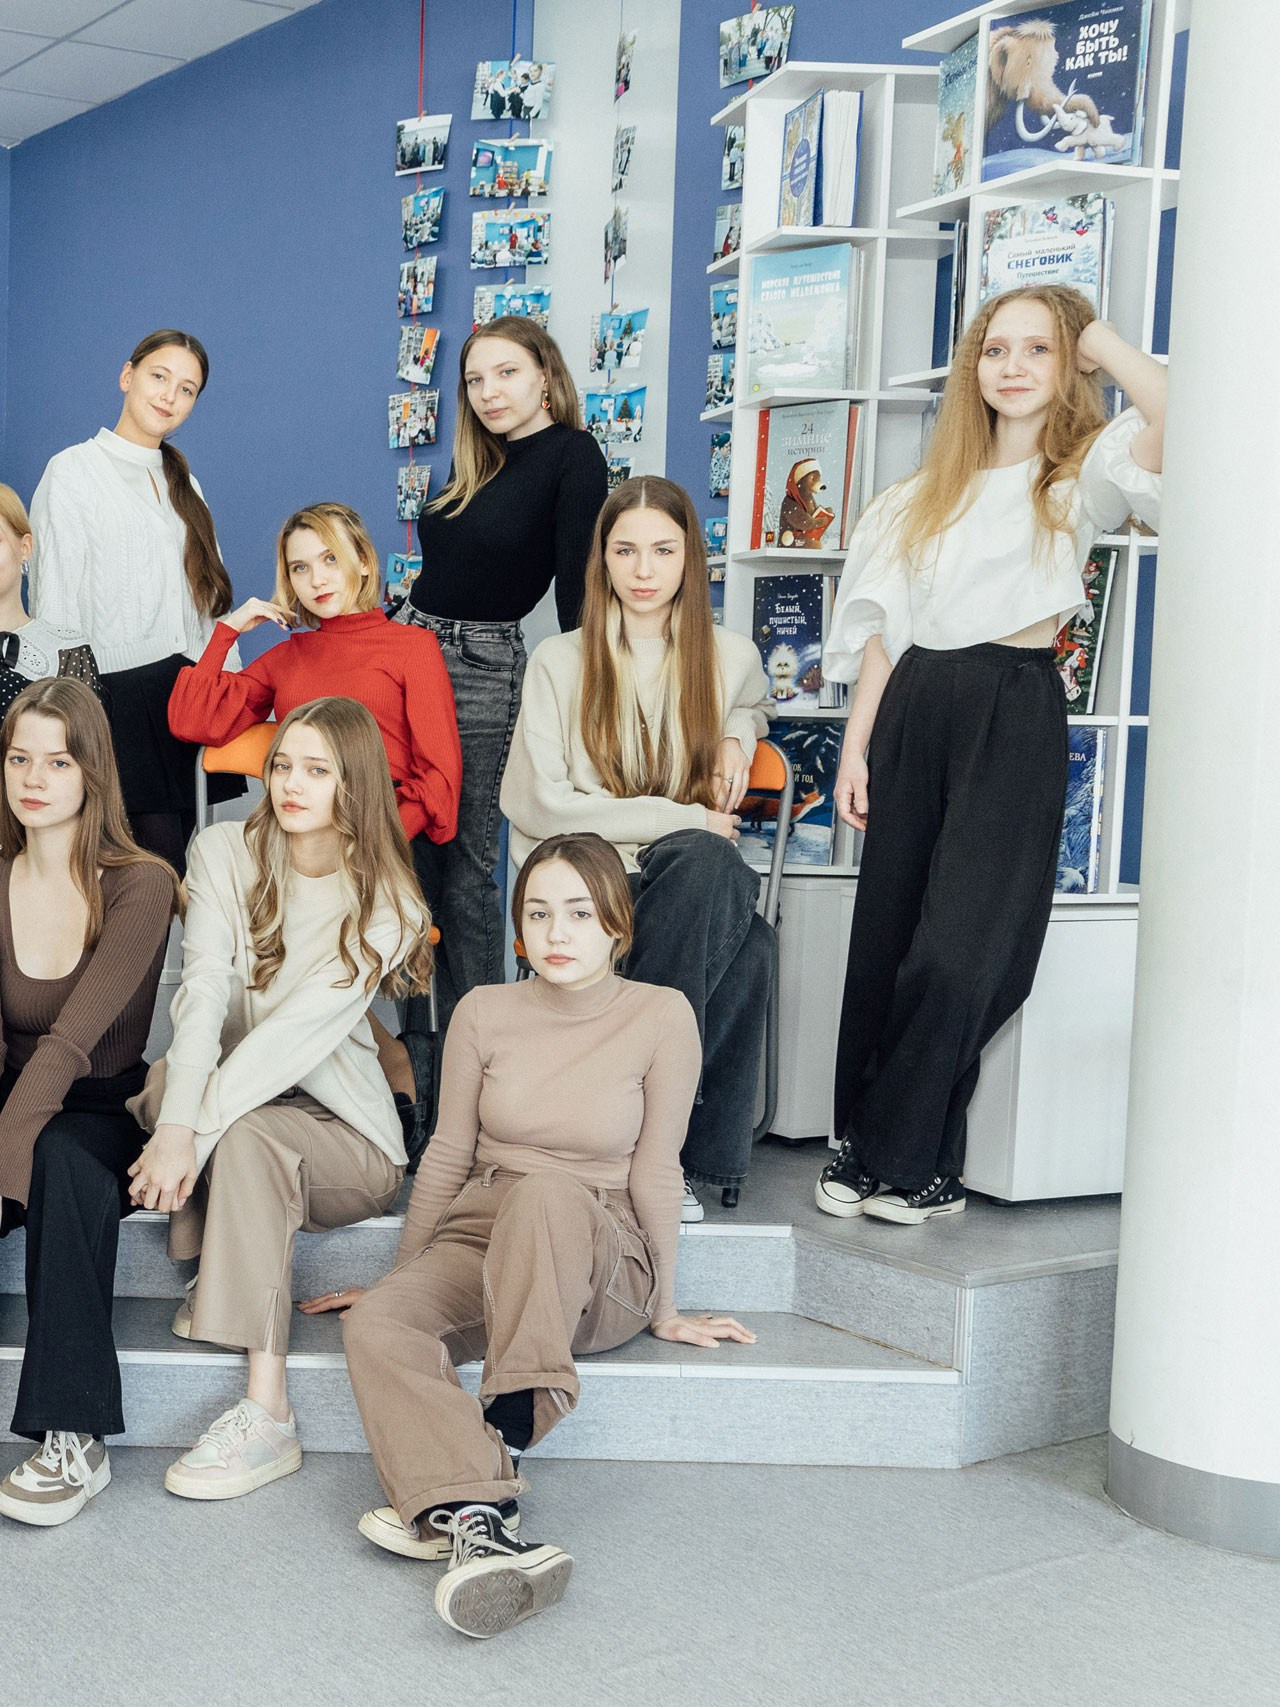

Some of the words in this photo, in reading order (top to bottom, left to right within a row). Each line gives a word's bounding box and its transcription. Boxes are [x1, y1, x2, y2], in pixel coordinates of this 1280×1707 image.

[1079, 19, 1119, 40] ХОЧУ
[1076, 35, 1119, 55] БЫТЬ
[1065, 53, 1095, 71] КАК
[1098, 45, 1128, 65] ТЫ!
[1007, 249, 1033, 259] Самый
[1035, 243, 1076, 255] маленький
[1007, 253, 1073, 269] СНЕГОВИК
[1017, 268, 1060, 280] Путешествие
[801, 423, 814, 435] 24
[787, 446, 826, 456] истории
[801, 774, 814, 784] ГОД
